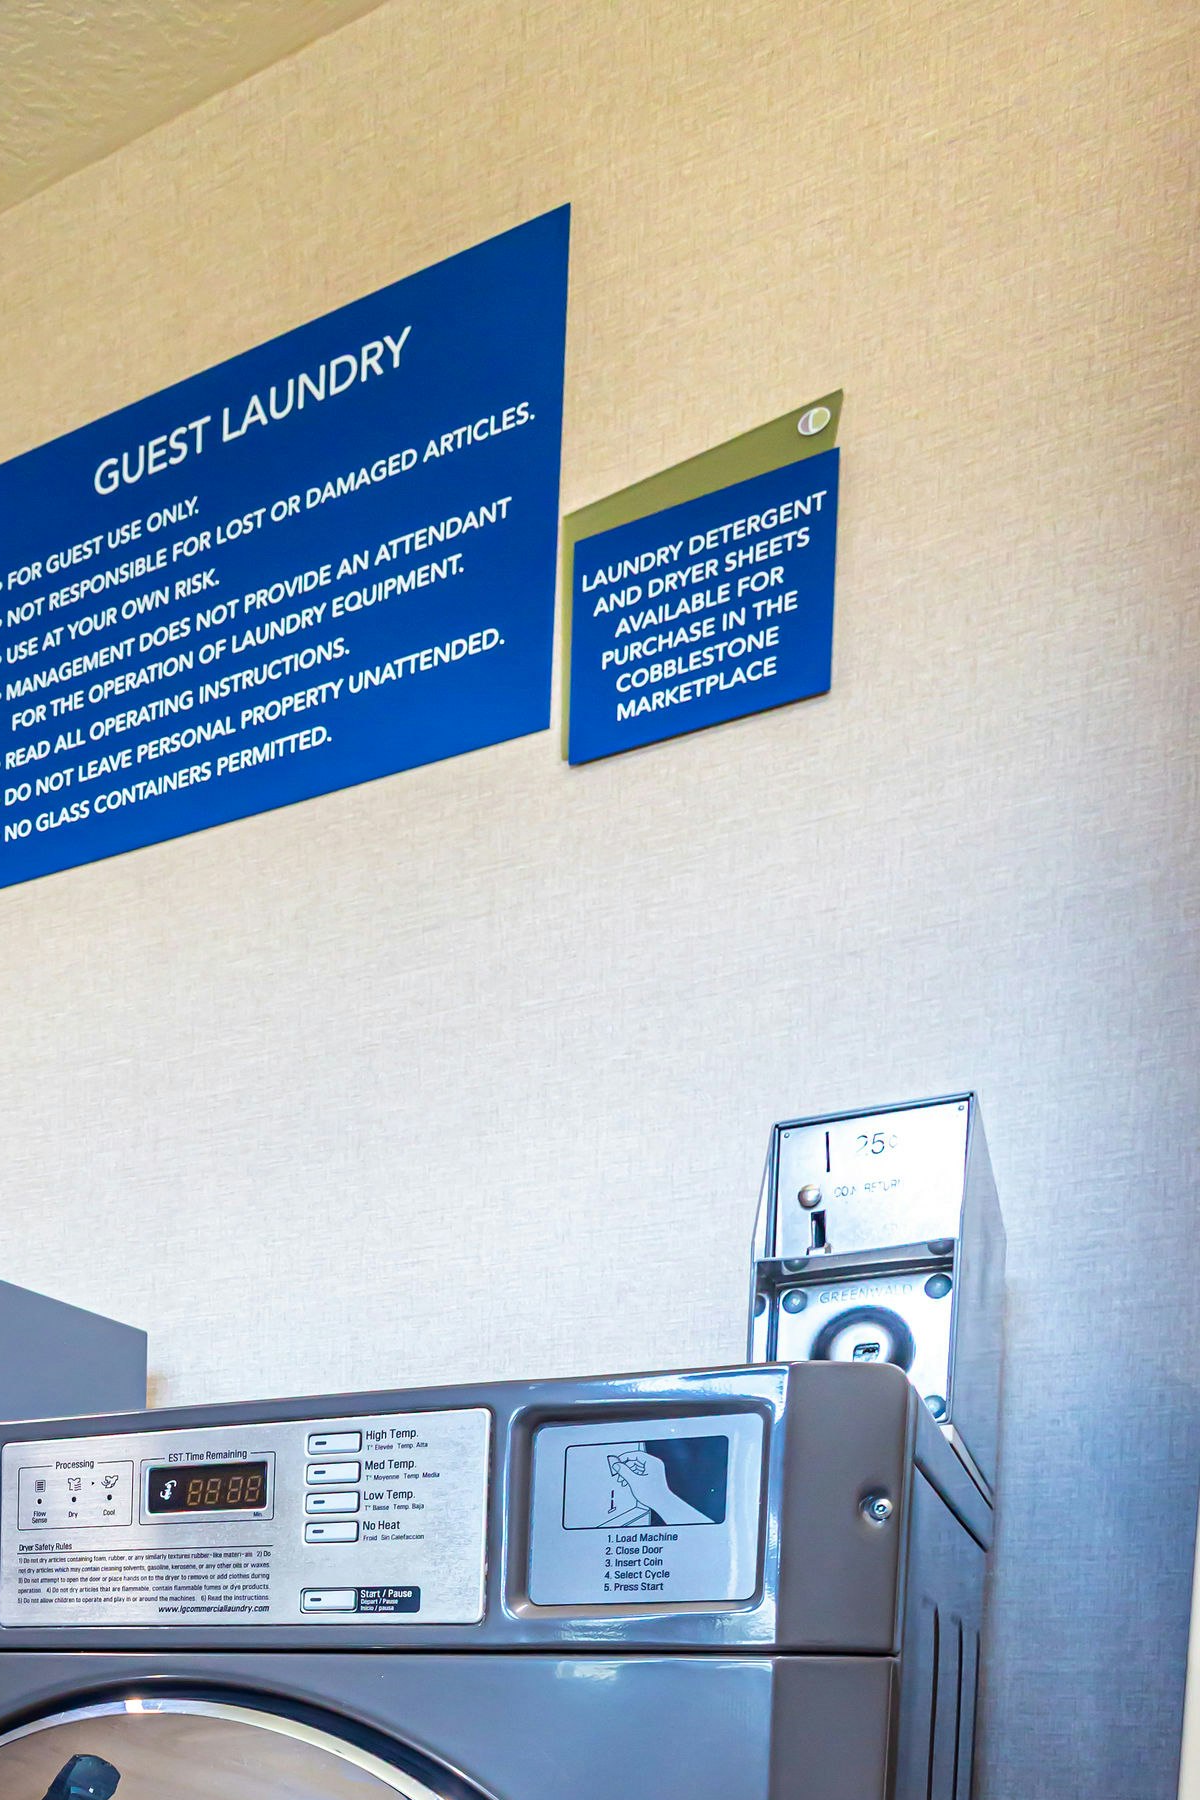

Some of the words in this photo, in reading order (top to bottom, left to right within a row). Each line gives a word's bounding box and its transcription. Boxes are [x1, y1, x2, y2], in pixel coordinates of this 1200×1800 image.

[95, 416, 210, 494] GUEST
[223, 326, 411, 442] LAUNDRY
[8, 597, 45, 627] NOT
[49, 548, 166, 610] RESPONSIBLE
[173, 531, 211, 561] FOR
[217, 508, 266, 544] LOST
[271, 495, 300, 521] OR
[306, 449, 417, 508] DAMAGED
[423, 402, 534, 462] ARTICLES.
[8, 562, 41, 590] FOR
[46, 535, 103, 573] GUEST
[108, 520, 141, 548] USE
[147, 496, 198, 532] ONLY.
[582, 541, 683, 592] LAUNDRY
[689, 491, 826, 555] DETERGENT
[6, 638, 135, 700] MANAGEMENT
[140, 617, 190, 652] DOES
[196, 599, 239, 631] NOT
[245, 565, 331, 613] PROVIDE
[337, 550, 368, 579] AN
[374, 497, 511, 565] ATTENDANT
[593, 586, 642, 616] AND
[648, 559, 718, 598] DRYER
[725, 527, 809, 572] SHEETS
[615, 583, 730, 637] AVAILABLE
[738, 566, 784, 597] FOR
[7, 637, 38, 663] USE
[42, 627, 63, 650] AT
[67, 607, 117, 639] YOUR
[121, 586, 169, 619] OWN
[175, 569, 219, 600] RISK.
[12, 705, 46, 731] FOR
[50, 691, 84, 716] THE
[89, 651, 193, 703] OPERATION
[199, 639, 226, 664] OF
[232, 603, 326, 653] LAUNDRY
[332, 553, 463, 617] EQUIPMENT.
[602, 617, 715, 670] PURCHASE
[723, 607, 745, 631] IN
[752, 590, 797, 620] THE
[616, 626, 779, 692] COBBLESTONE
[617, 656, 776, 721] MARKETPLACE
[5, 783, 31, 806] DO
[36, 768, 74, 796] NOT
[79, 749, 132, 782] LEAVE
[137, 717, 236, 763] PERSONAL
[241, 678, 343, 729] PROPERTY
[349, 628, 504, 693] UNATTENDED.
[6, 741, 50, 769] READ
[54, 729, 85, 753] ALL
[90, 690, 193, 740] OPERATING
[199, 637, 349, 704] INSTRUCTIONS.
[5, 819, 31, 842] NO
[36, 800, 89, 831] GLASS
[94, 762, 211, 813] CONTAINERS
[217, 726, 331, 776] PERMITTED.
[55, 1460, 94, 1469] Processing
[186, 1453, 204, 1461] Time
[206, 1450, 247, 1460] Remaining
[365, 1460, 385, 1470] Med
[388, 1460, 416, 1470] Temp.
[366, 1430, 386, 1441] High
[390, 1429, 418, 1439] Temp.
[363, 1521, 375, 1530] No
[378, 1520, 400, 1530] Heat
[364, 1491, 384, 1500] Low
[386, 1490, 415, 1500] Temp.
[19, 1544, 33, 1552] Dryer
[35, 1544, 55, 1552] Safety
[605, 1547, 613, 1555] 2.
[616, 1546, 640, 1555] Close
[642, 1546, 663, 1554] Door
[605, 1559, 612, 1567] 3.
[615, 1559, 641, 1567] Insert
[643, 1558, 663, 1566] Coin
[608, 1535, 613, 1543] 1.
[616, 1534, 638, 1542] Load
[640, 1533, 678, 1542] Machine
[360, 1589, 380, 1598] Start
[388, 1589, 412, 1598] Pause
[604, 1583, 611, 1591] 5.
[614, 1583, 638, 1591] Press
[641, 1582, 664, 1591] Start
[605, 1571, 612, 1579] 4.
[615, 1571, 642, 1579] Select
[645, 1570, 670, 1579] Cycle
[159, 1605, 270, 1614] www.lgcommerciallaundry.com
